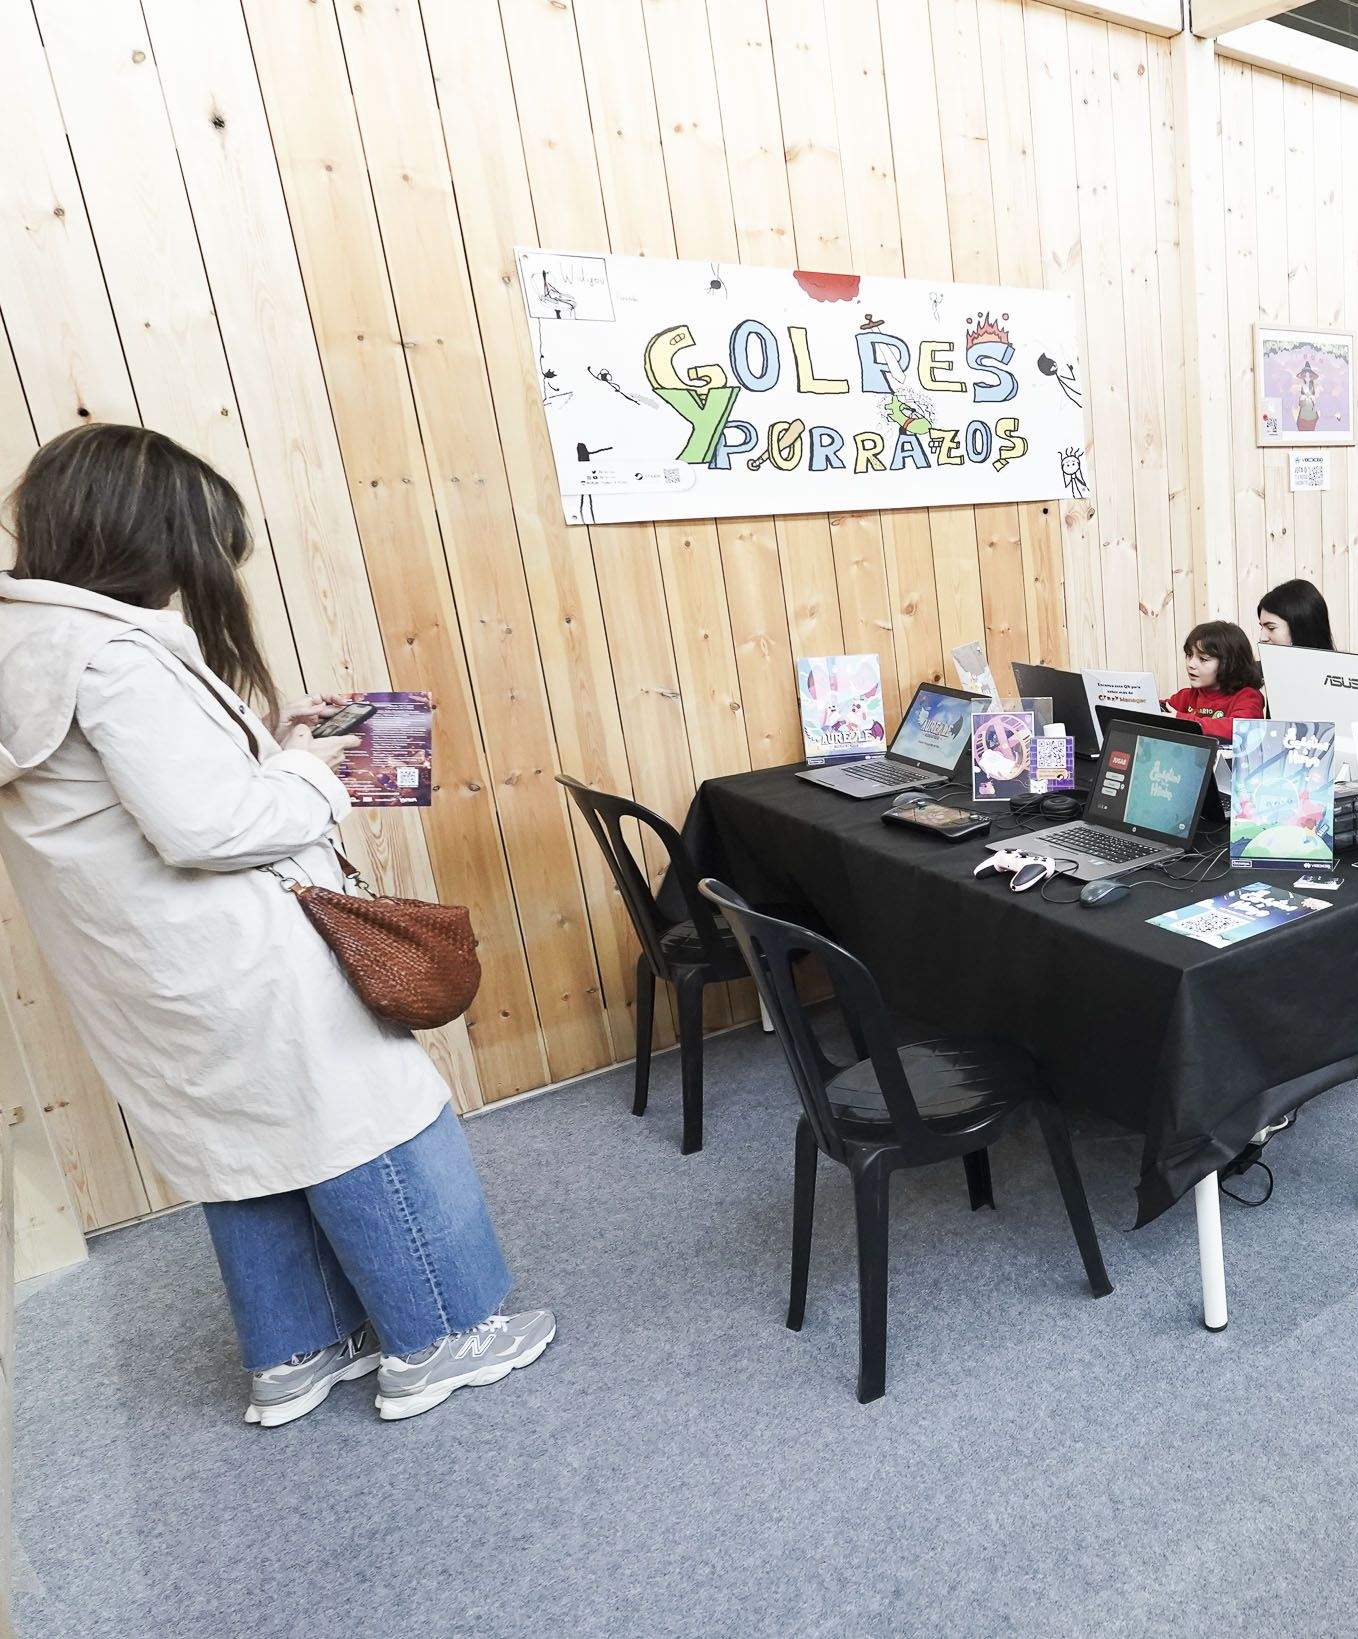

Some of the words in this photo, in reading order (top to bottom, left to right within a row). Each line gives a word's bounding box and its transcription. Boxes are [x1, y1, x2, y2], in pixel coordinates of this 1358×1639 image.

[644, 319, 1019, 402] GOLPES
[653, 386, 741, 464] Y
[708, 417, 1029, 474] PORRAZOS
